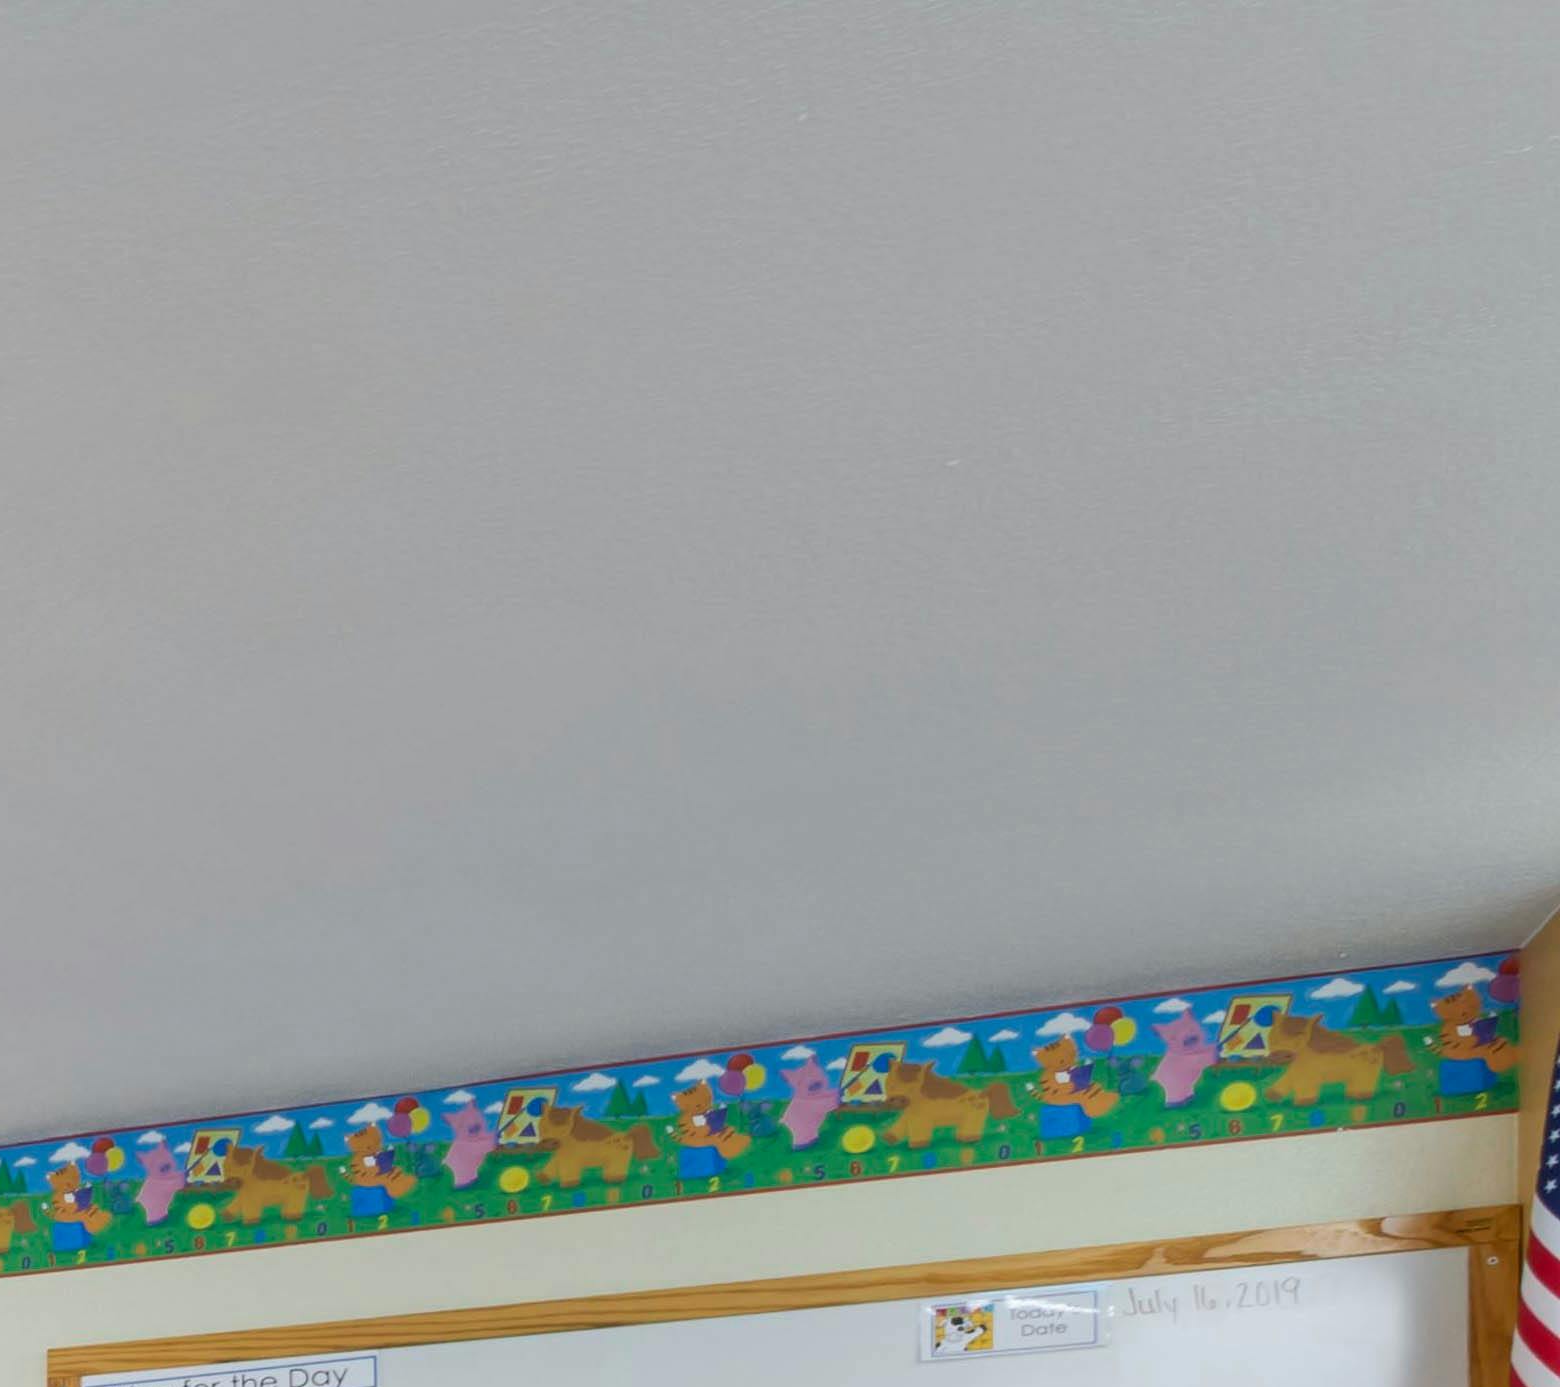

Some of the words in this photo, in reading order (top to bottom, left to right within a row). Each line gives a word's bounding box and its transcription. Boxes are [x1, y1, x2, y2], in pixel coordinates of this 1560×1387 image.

[1121, 1287, 1180, 1324] July
[1234, 1275, 1302, 1311] 2019
[1020, 1323, 1068, 1337] Date
